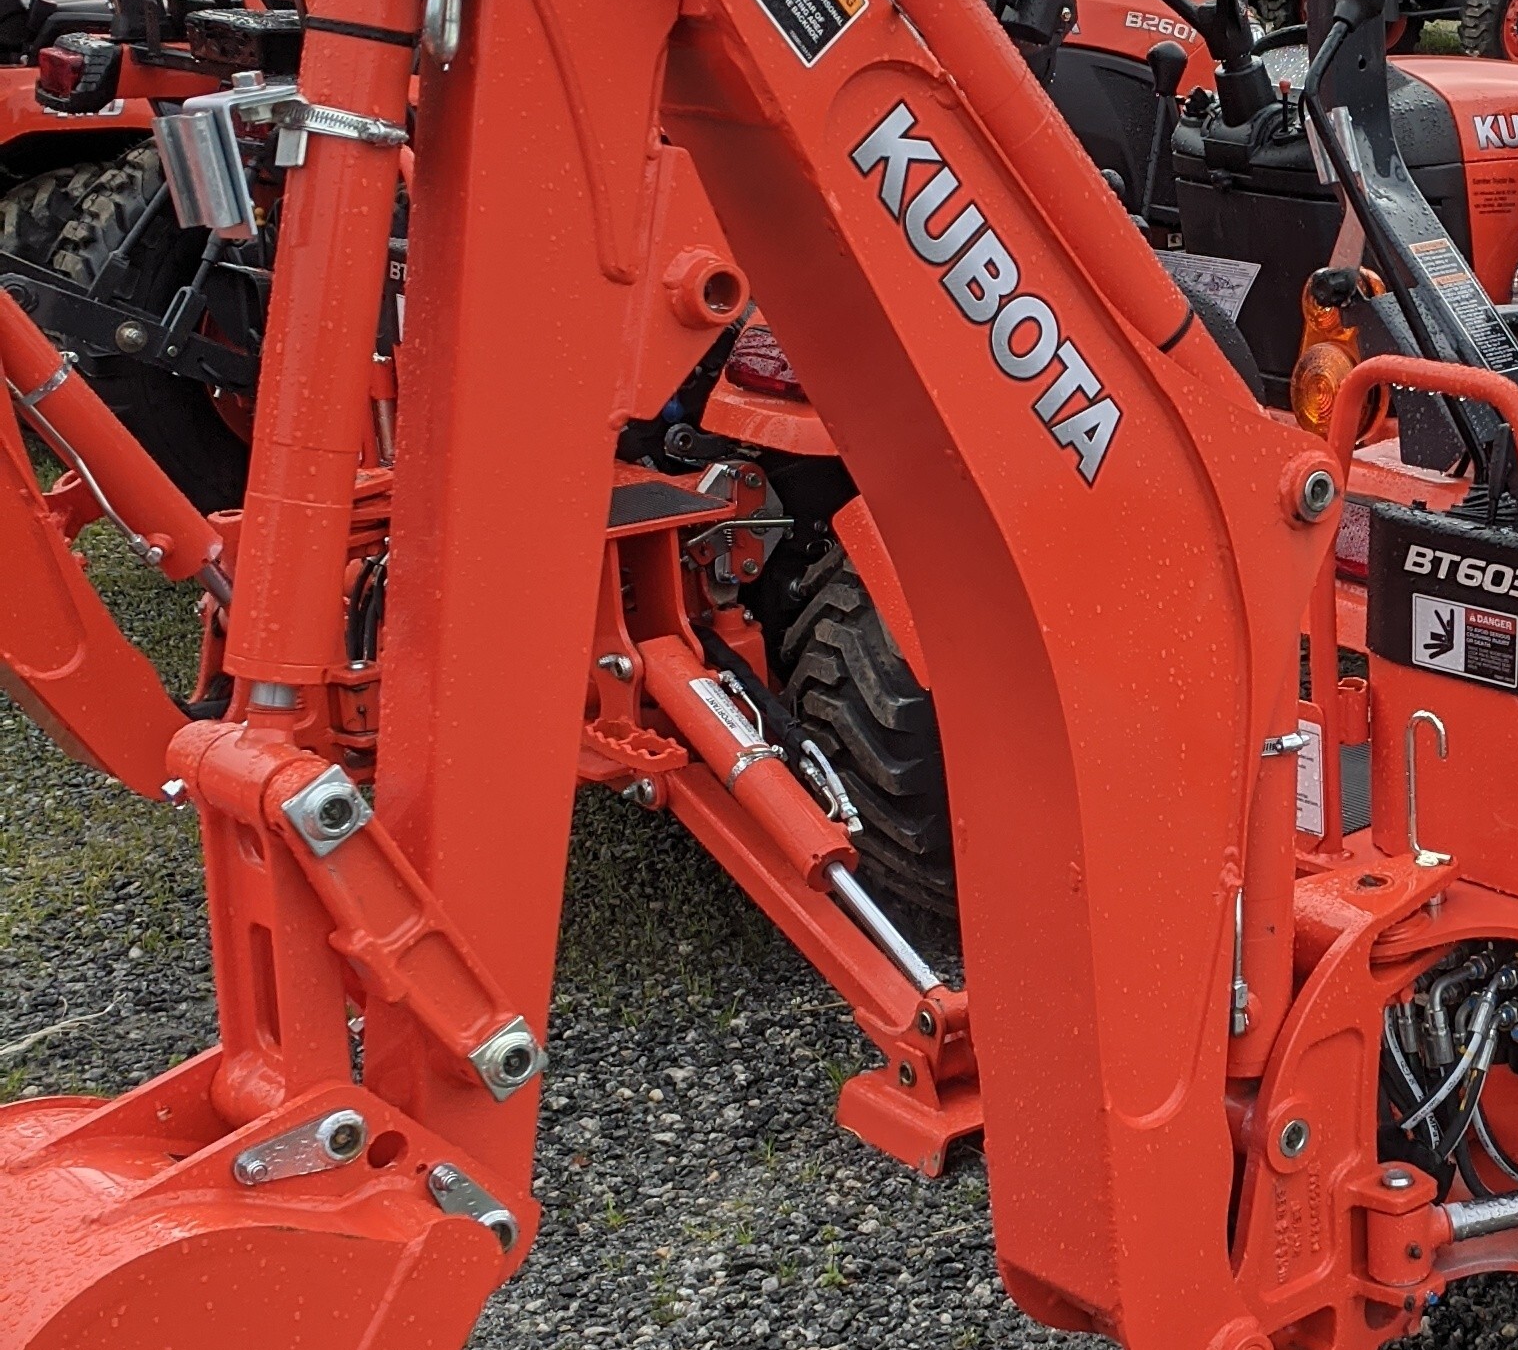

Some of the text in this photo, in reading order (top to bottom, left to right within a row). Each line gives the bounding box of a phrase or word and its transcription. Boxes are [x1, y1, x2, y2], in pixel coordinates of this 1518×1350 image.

[807, 14, 825, 37] AREA
[814, 11, 825, 23] OF
[1125, 11, 1198, 44] B2601
[852, 100, 1123, 488] KUBOTA
[1476, 615, 1513, 631] DANGER
[705, 697, 737, 729] IMPORTANT
